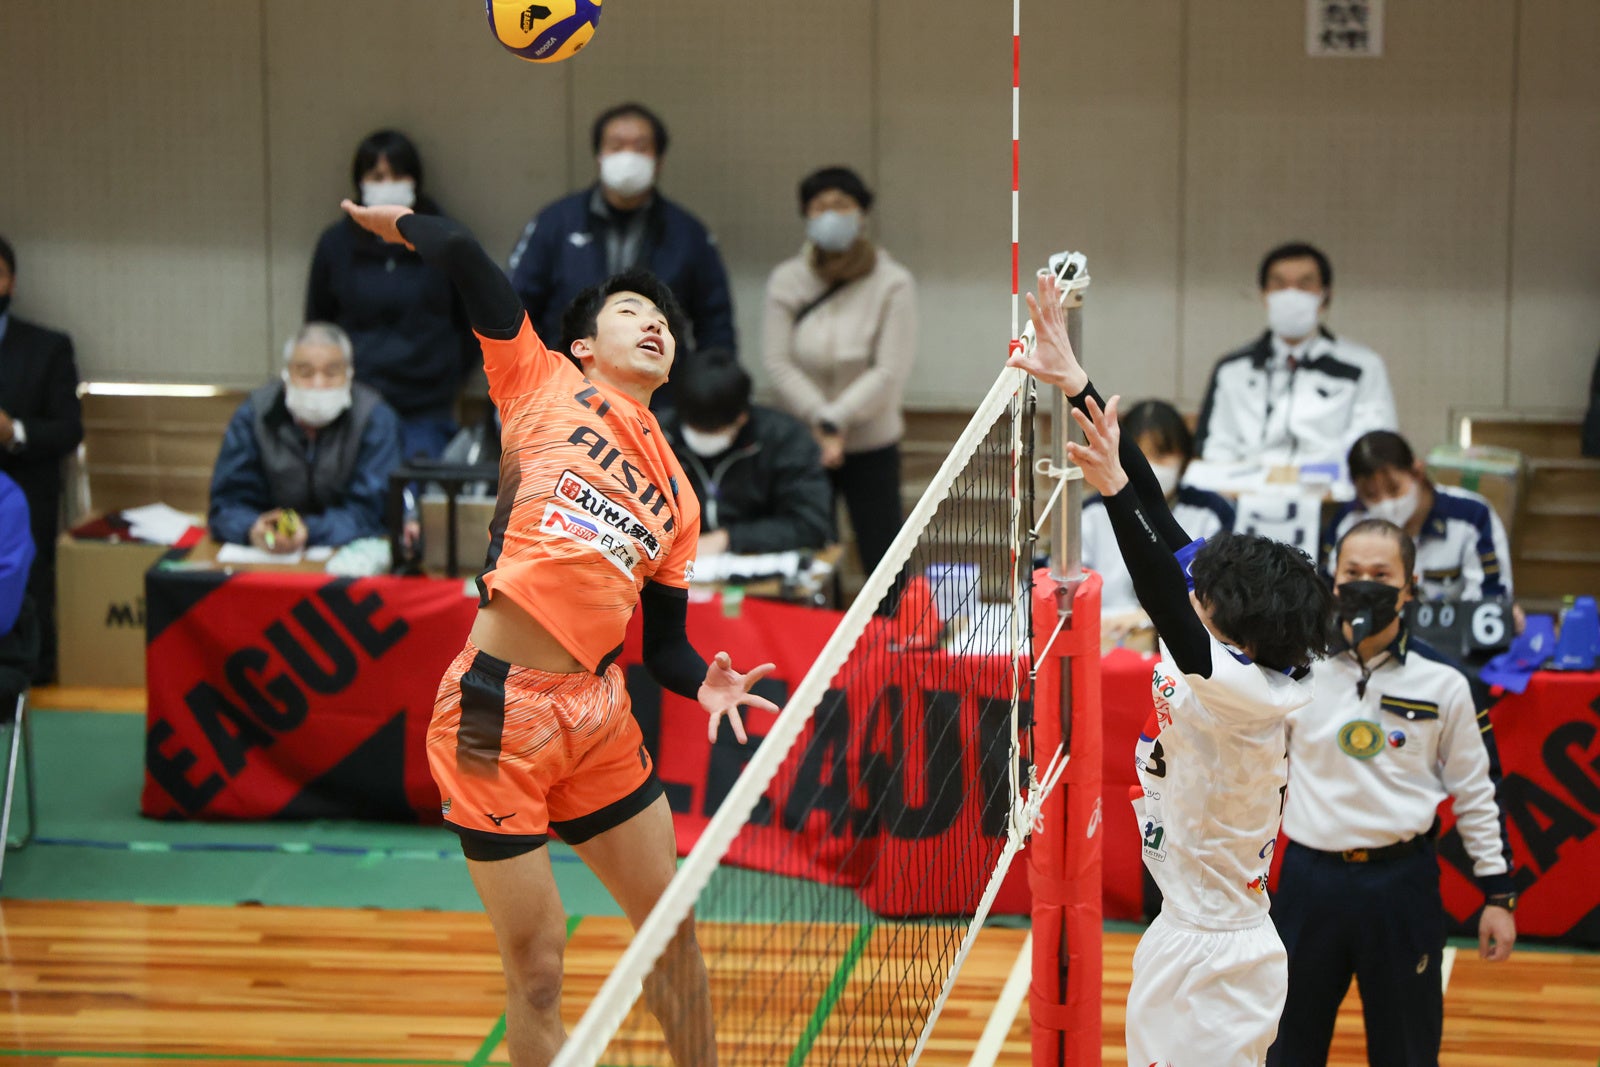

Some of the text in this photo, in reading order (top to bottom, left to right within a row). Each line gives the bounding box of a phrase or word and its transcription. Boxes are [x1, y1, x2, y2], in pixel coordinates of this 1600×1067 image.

[545, 510, 600, 542] NISSIN
[1471, 603, 1505, 645] 6
[146, 576, 410, 814] EAGUE
